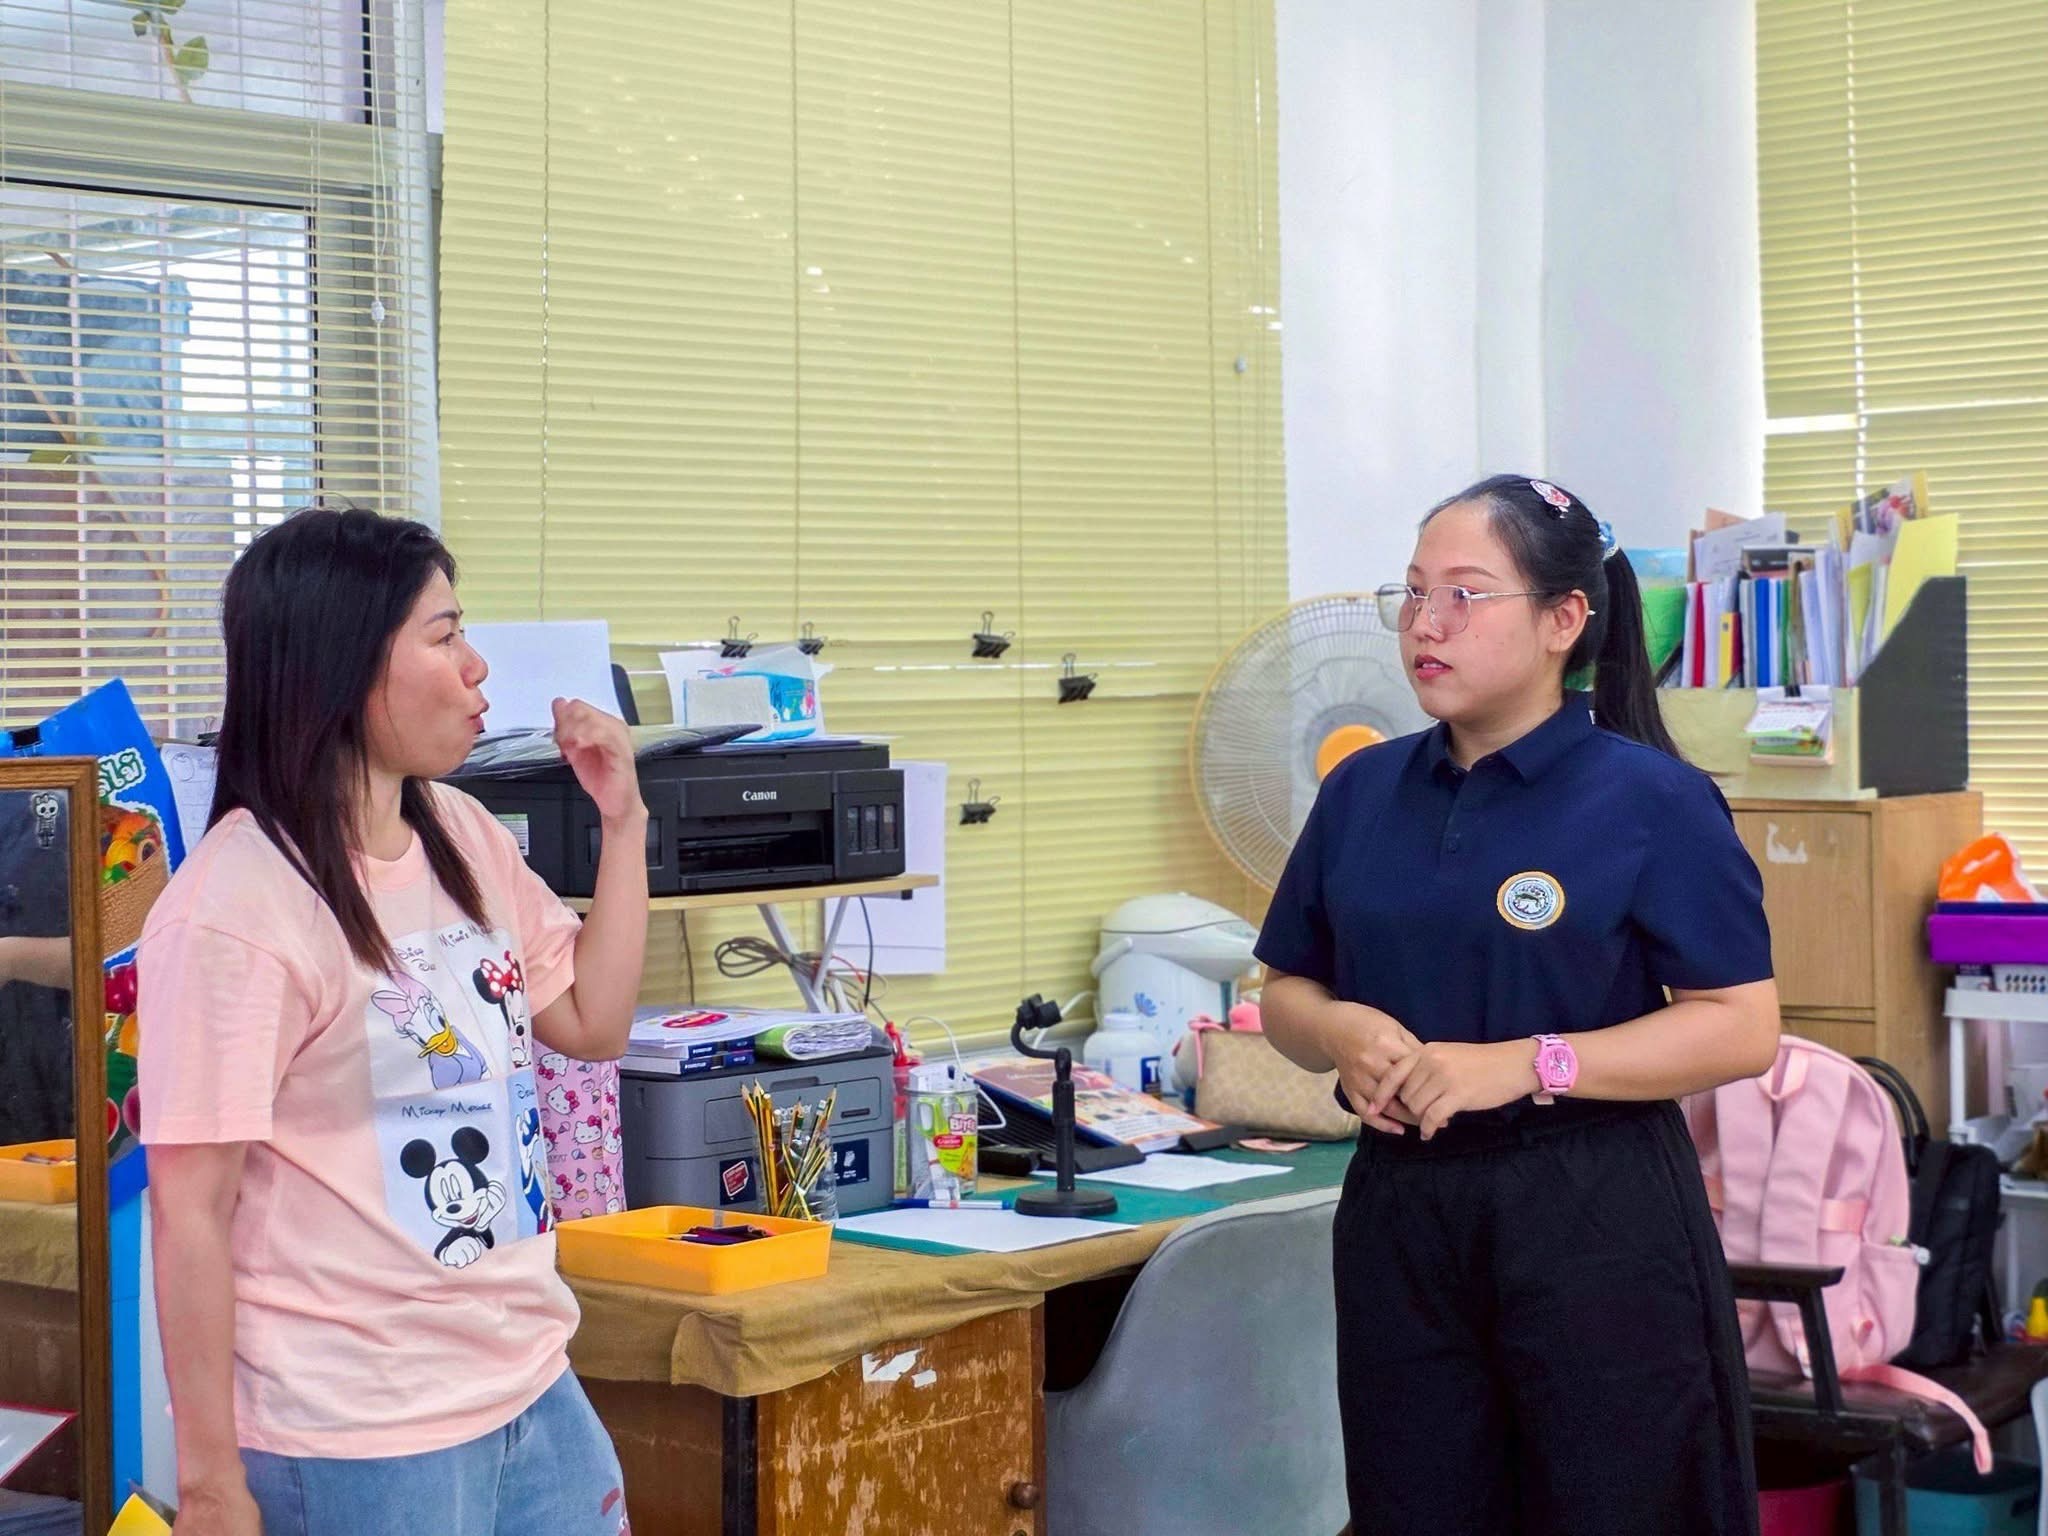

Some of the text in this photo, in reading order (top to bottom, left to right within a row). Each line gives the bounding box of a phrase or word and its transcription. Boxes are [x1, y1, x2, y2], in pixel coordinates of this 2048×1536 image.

[742, 790, 777, 801] Canon
[401, 1101, 493, 1119] Mickey Mouse
